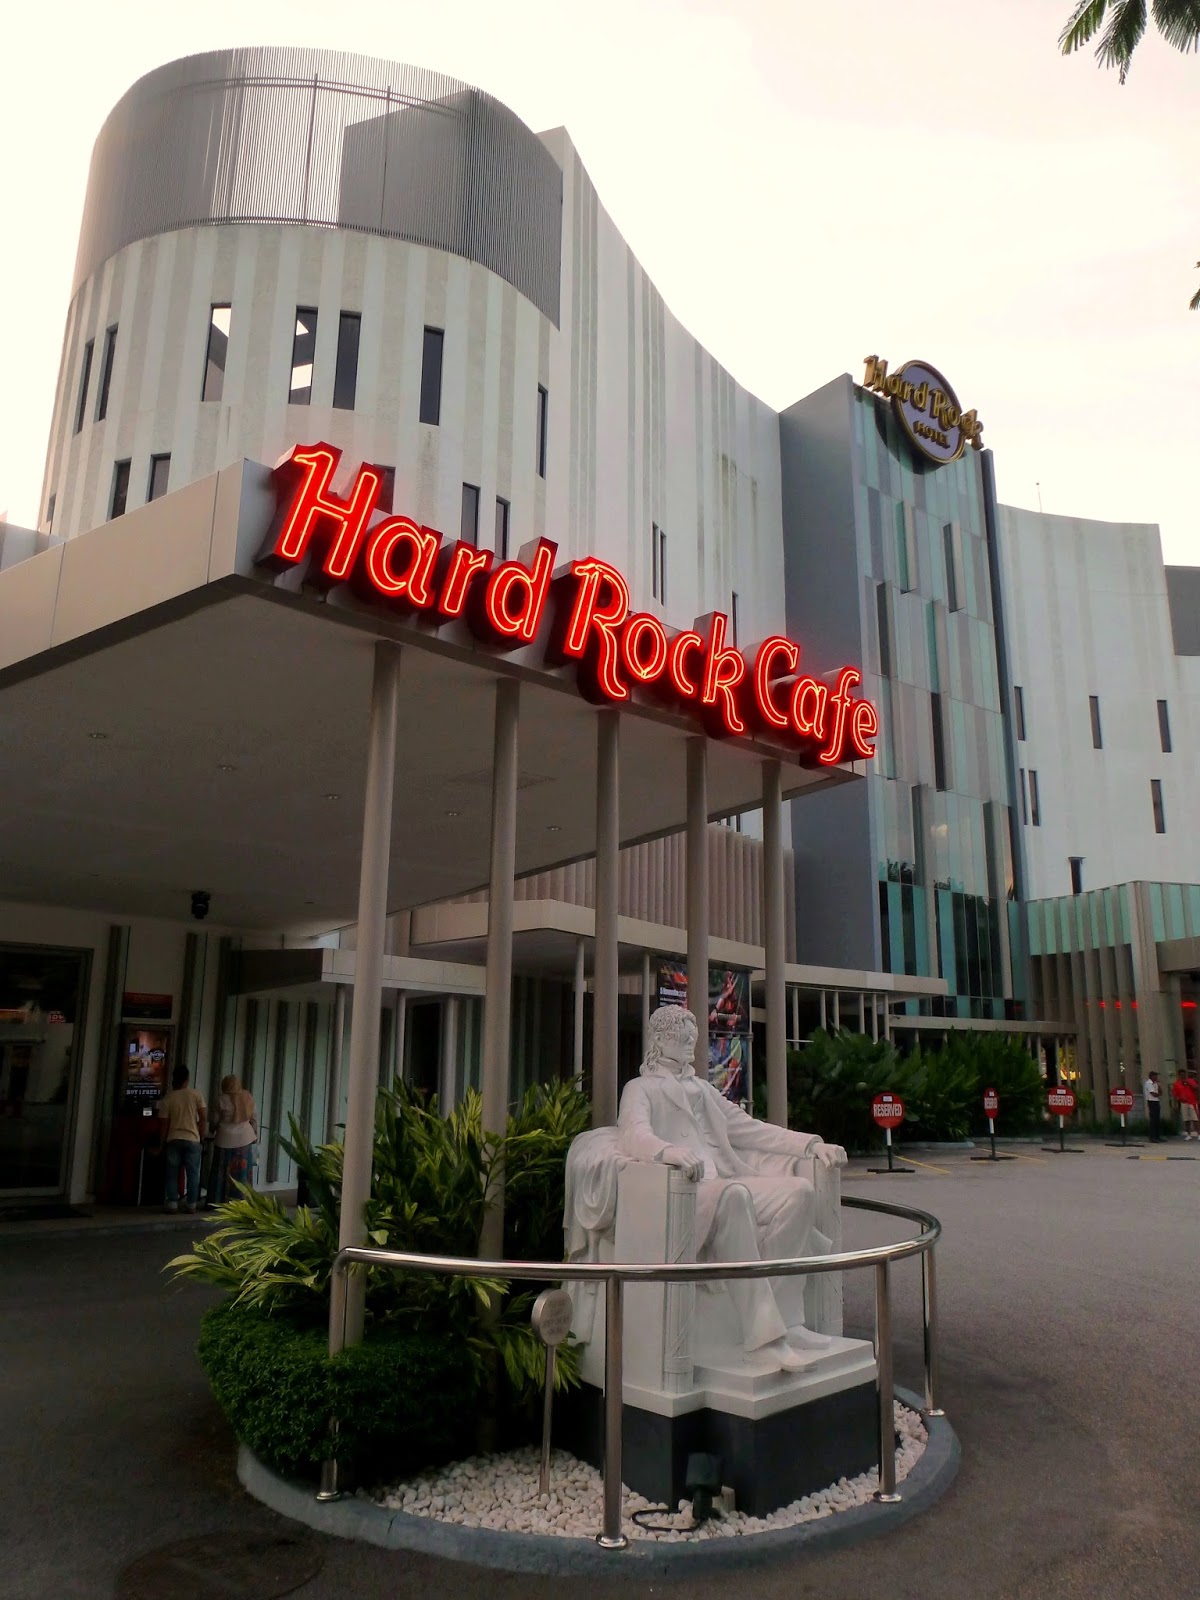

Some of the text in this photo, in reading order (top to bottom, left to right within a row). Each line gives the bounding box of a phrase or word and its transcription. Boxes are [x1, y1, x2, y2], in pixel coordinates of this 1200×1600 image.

[863, 355, 984, 450] Hard Rock
[270, 441, 879, 766] Hard Rock Cafe
[1048, 1094, 1074, 1106] RESERVED
[1110, 1095, 1133, 1106] RESERVED
[873, 1103, 903, 1117] RESERVED
